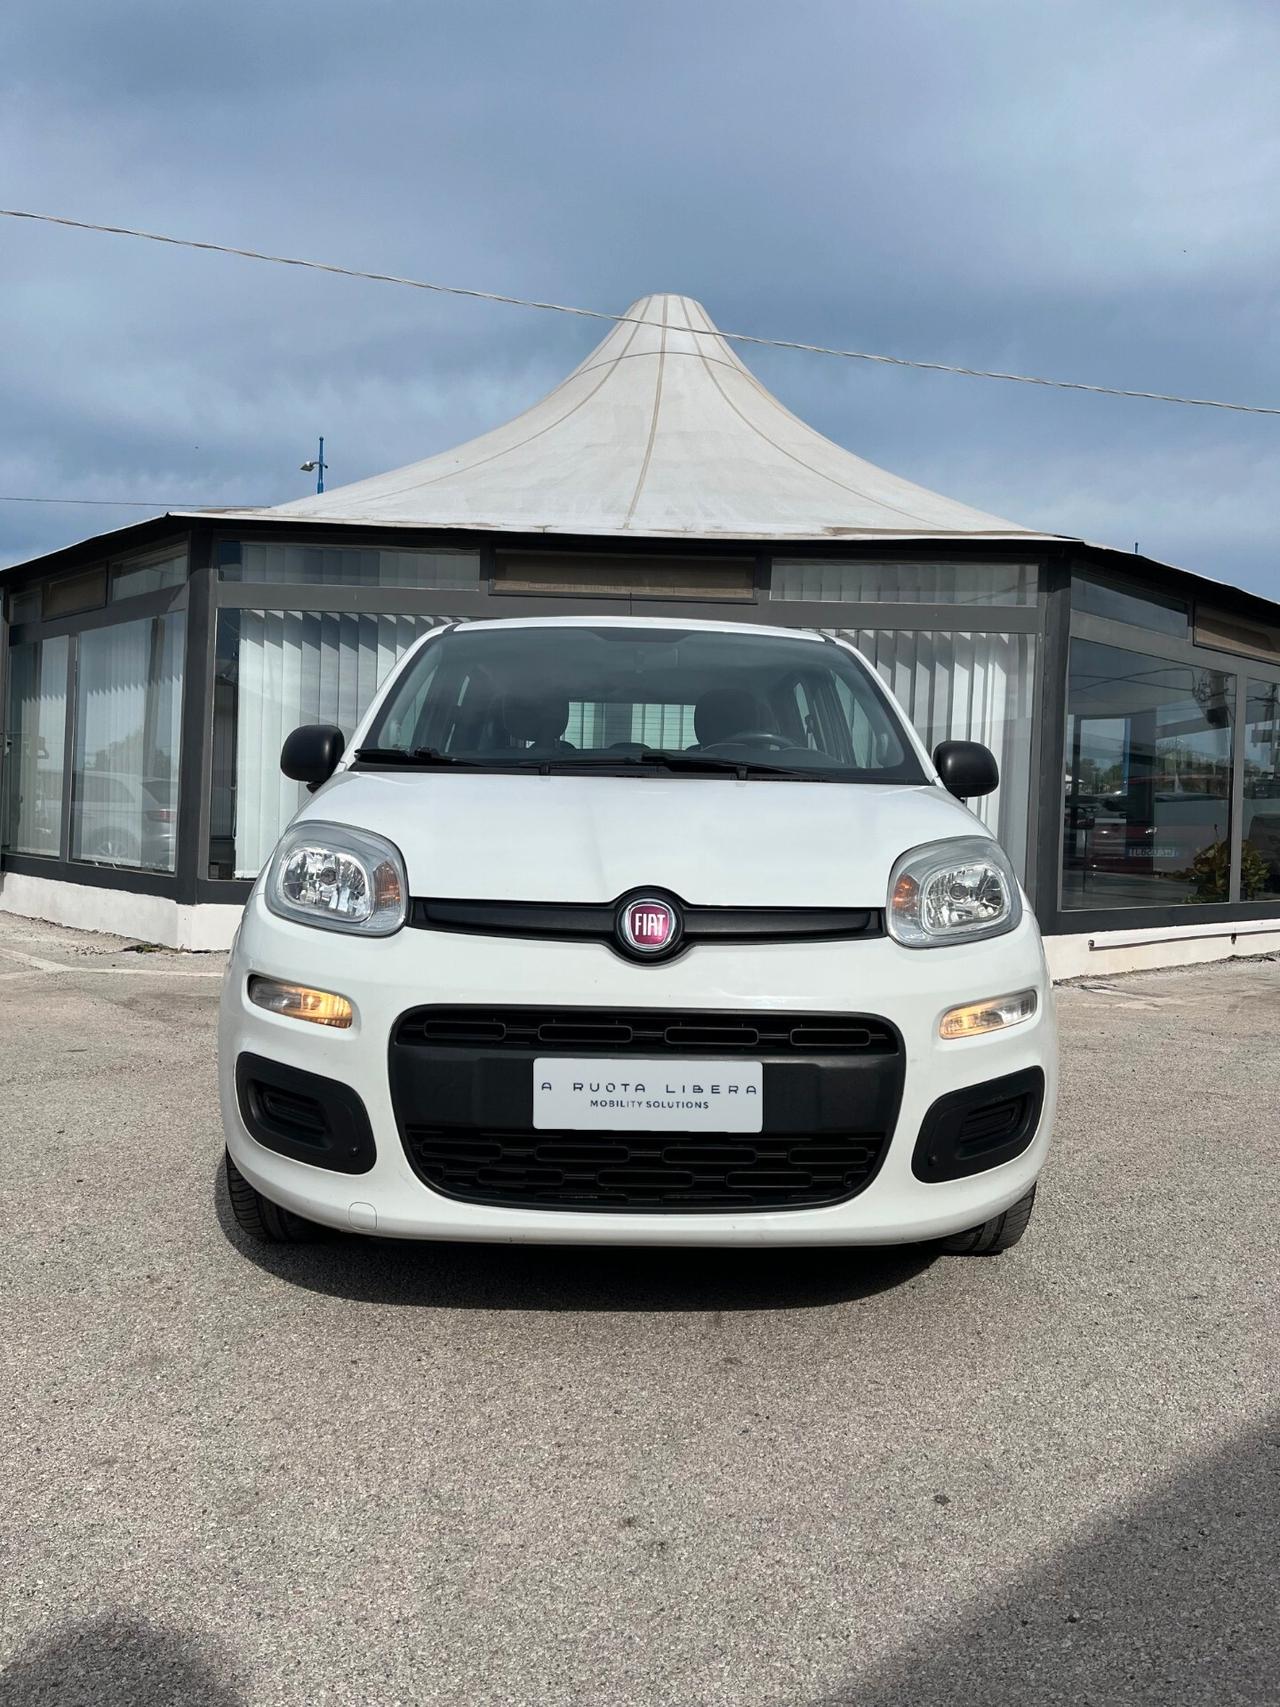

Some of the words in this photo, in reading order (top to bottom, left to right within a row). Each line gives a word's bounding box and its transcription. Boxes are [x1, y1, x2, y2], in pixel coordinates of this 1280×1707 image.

[635, 913, 666, 937] FIAT
[541, 1082, 552, 1092] A
[573, 1083, 646, 1093] RUOTA
[666, 1084, 757, 1095] LIBERA
[590, 1100, 642, 1108] MOBILITY
[646, 1101, 709, 1109] SOLUTIONS
